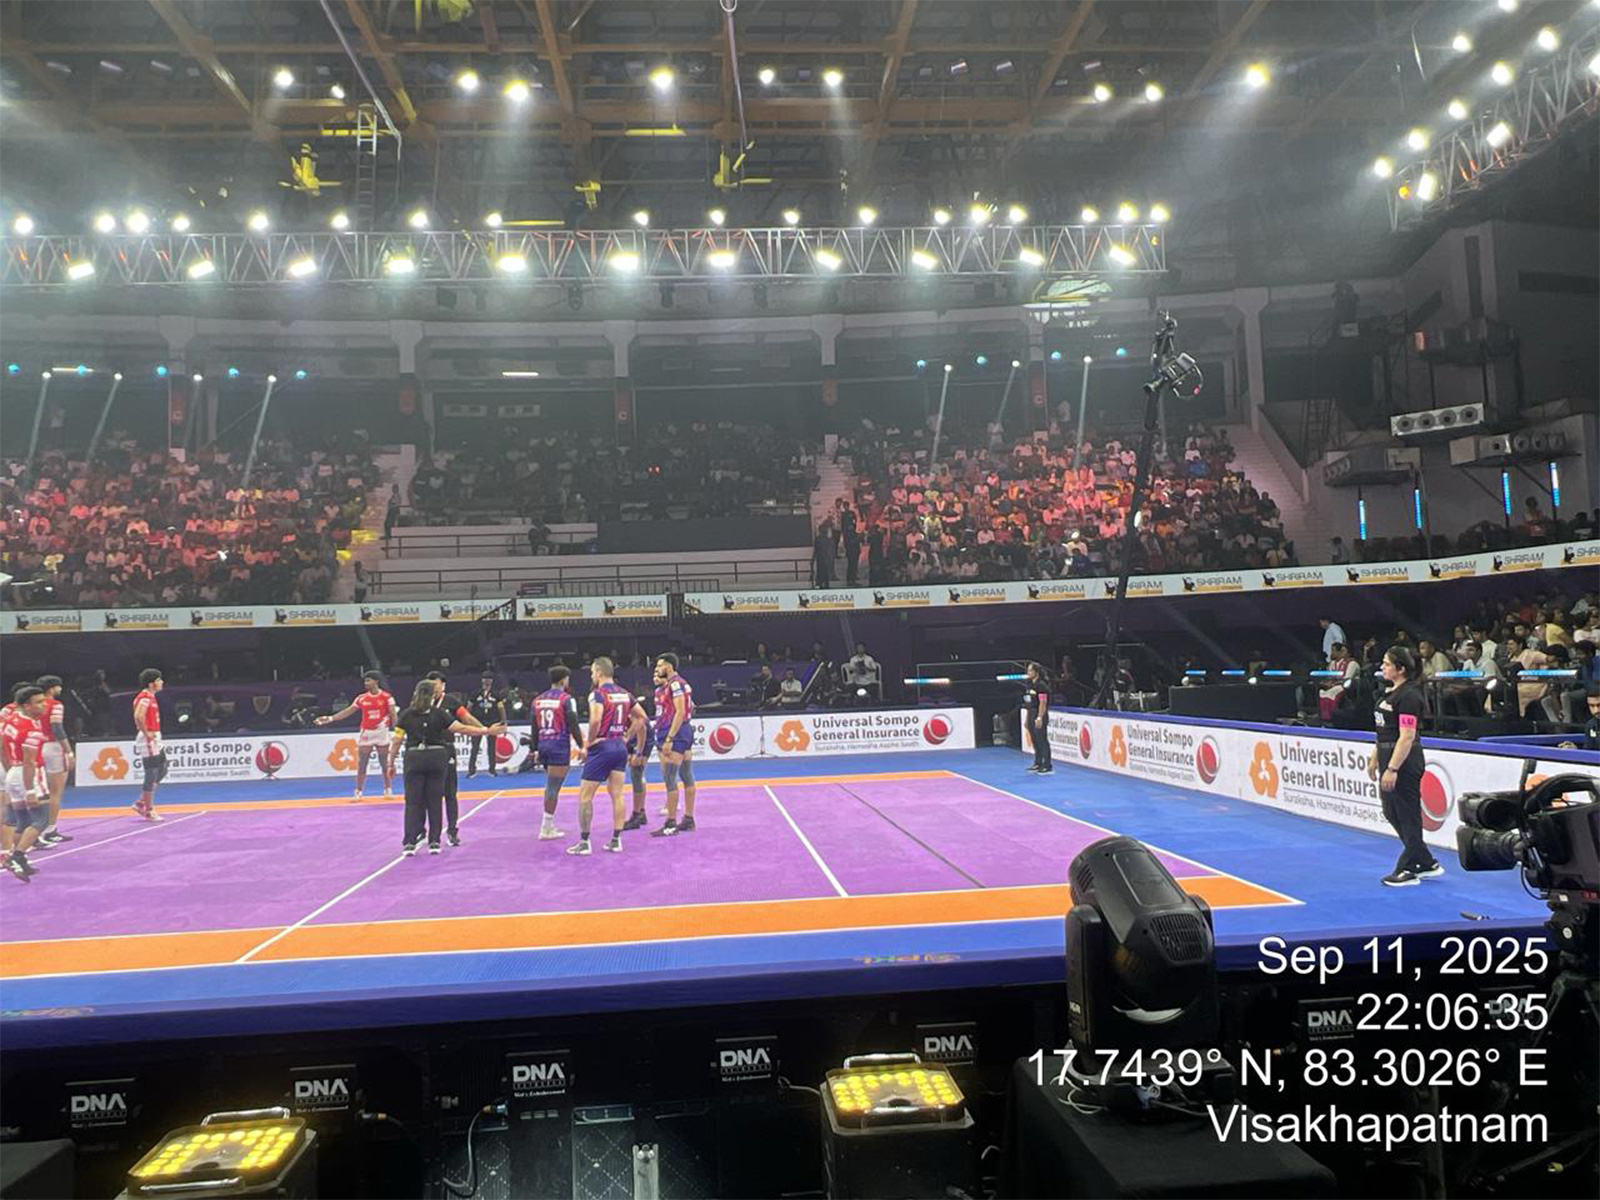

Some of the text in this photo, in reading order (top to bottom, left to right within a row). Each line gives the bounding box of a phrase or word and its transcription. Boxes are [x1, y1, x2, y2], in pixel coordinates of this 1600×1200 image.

[1504, 552, 1545, 564] SHRIRAM
[1360, 567, 1409, 577] SHRIRAM
[1441, 561, 1477, 573] SHRIRAM
[1196, 576, 1242, 586] SHRIRAM
[1276, 571, 1324, 581] SHRIRAM
[961, 588, 1005, 598] SHRIRAM
[1041, 584, 1085, 594] SHRIRAM
[736, 596, 779, 605] SHRIRAM
[811, 594, 854, 604] SHRIRAM
[886, 591, 930, 601] SHRIRAM
[537, 602, 583, 612] SHRIRAM
[617, 600, 662, 610] SHRIRAM
[119, 613, 169, 623] SHRIRAM
[205, 611, 253, 621] SHRIRAM
[288, 610, 335, 619] SHRIRAM
[373, 607, 419, 617] SHRIRAM
[31, 614, 81, 624] SHRIRAM
[540, 709, 554, 728] 19
[616, 703, 623, 724] 1
[813, 715, 919, 729] Universal Sompo
[1059, 717, 1078, 733] Sompo
[813, 726, 920, 741] General Insurance
[1127, 724, 1193, 748] Universal Sompo
[203, 742, 252, 755] Sompo
[188, 755, 252, 767] Insurance
[1128, 743, 1195, 767] General Insurance
[1280, 741, 1344, 769] Universal
[1281, 766, 1377, 799] General Insura
[1308, 1009, 1353, 1027] DNA
[924, 1035, 973, 1053] DNA
[720, 1047, 771, 1067] DNA
[513, 1063, 565, 1082] DNA
[295, 1078, 349, 1098] DNA
[71, 1093, 126, 1112] DNA
